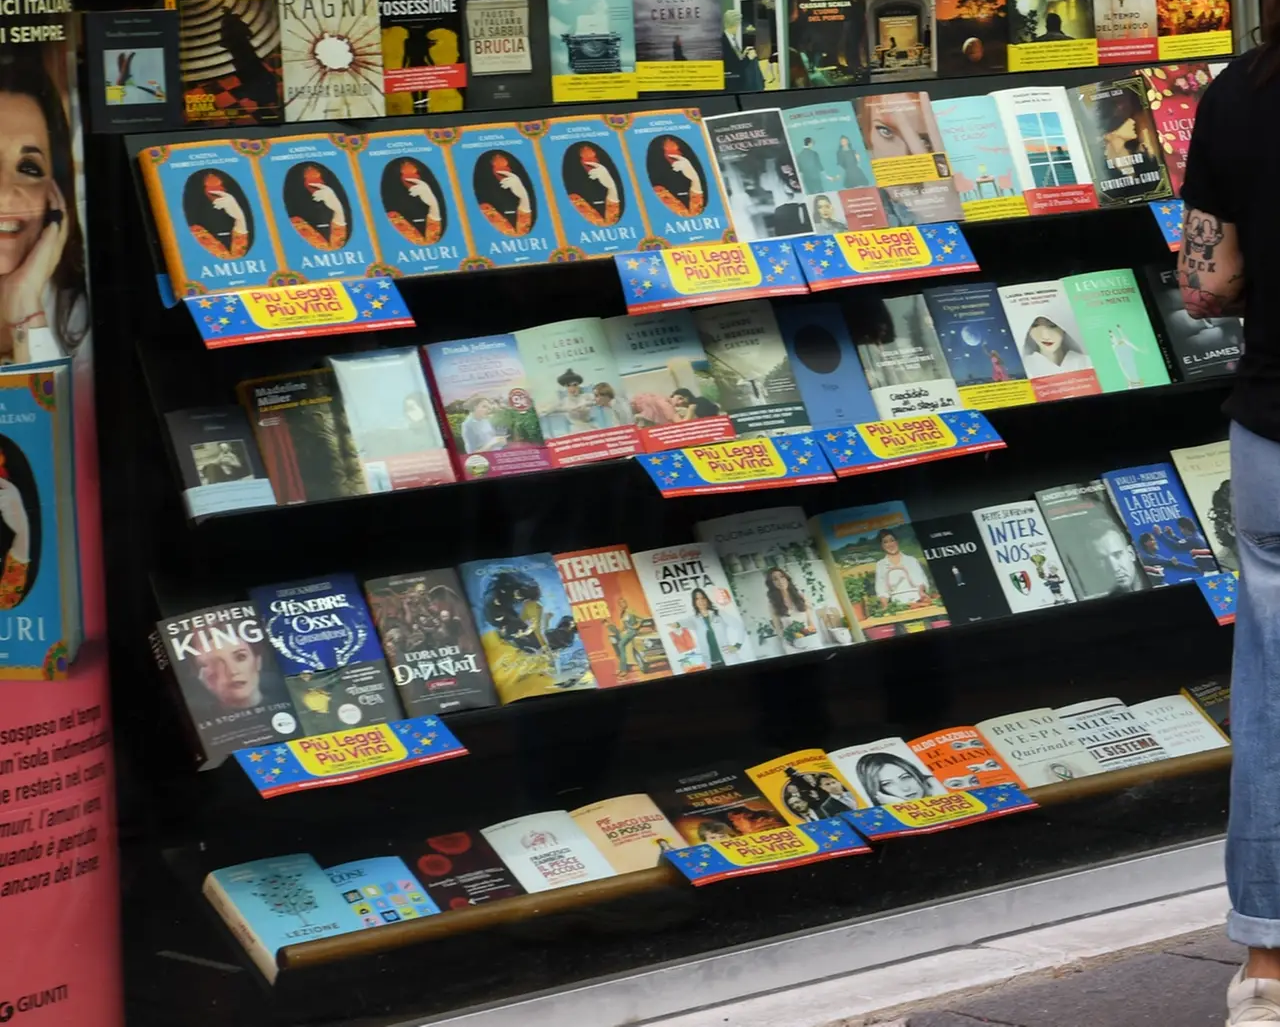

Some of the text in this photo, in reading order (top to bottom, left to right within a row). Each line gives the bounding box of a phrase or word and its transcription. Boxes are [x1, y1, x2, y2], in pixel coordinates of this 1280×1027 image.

[651, 7, 701, 22] CENERE
[1113, 12, 1141, 20] TEMPO
[1113, 22, 1149, 31] DIAVOLO
[475, 38, 525, 55] BRUCIA
[579, 226, 637, 244] AMURI
[664, 216, 720, 236] AMURI
[489, 236, 548, 255] AMURI
[845, 229, 914, 247] Più Leggi
[302, 250, 365, 270] AMURI
[396, 243, 459, 264] AMURI
[672, 244, 746, 266] Più Leggi
[858, 243, 920, 261] Più Vinci
[200, 258, 267, 278] AMURI
[685, 261, 750, 281] Più Vinci
[1075, 275, 1130, 293] LEVANTE
[287, 284, 337, 304] Leggi
[298, 297, 343, 312] Vinci
[553, 337, 584, 349] LEONI
[555, 346, 596, 360] SICILIA
[1203, 346, 1239, 361] JAMES
[255, 382, 308, 396] Madeline
[257, 393, 291, 407] Miller
[865, 417, 935, 436] Più Leggi
[881, 431, 944, 448] Più Vinci
[693, 442, 768, 461] Più Leggi
[708, 455, 773, 473] Più Vinci
[1124, 490, 1177, 511] LA BELLA
[1131, 504, 1181, 526] STAGIONE
[714, 522, 804, 543] CUCINA BOTANICA
[987, 517, 1044, 546] INTER
[923, 541, 977, 561] LUISMO
[995, 543, 1030, 565] NOS
[662, 560, 710, 580] ANTI-
[659, 574, 716, 595] DIETA
[166, 605, 256, 636] STEPHEN
[292, 612, 343, 633] OSSA
[171, 620, 264, 661] KING
[439, 646, 460, 658] DEI
[992, 715, 1054, 736] BRUNO
[1069, 711, 1136, 733] SALLUSTI
[0, 720, 56, 745] sospeso
[299, 730, 386, 754] Più Leggi
[1003, 727, 1062, 746] VESPA
[1077, 724, 1147, 746] PALAMARA
[318, 743, 392, 766] Più Vinci
[912, 740, 935, 752] ALDO
[925, 748, 946, 760] LE
[1011, 737, 1075, 761] Quirinale
[1091, 736, 1159, 760] IL SISTEMA
[15, 771, 62, 801] resterà
[703, 790, 742, 806] ROMA
[922, 795, 967, 810] Leggi
[939, 800, 974, 812] Vinci
[606, 822, 652, 839] IO POSSO
[751, 828, 797, 847] Leggi
[766, 839, 805, 855] Vinci
[542, 862, 586, 879] PICCOLO
[549, 855, 579, 871] PESCE
[1, 861, 73, 897] ancora del
[286, 922, 340, 939] LEZIONE
[17, 983, 68, 1013] GIUNTI
